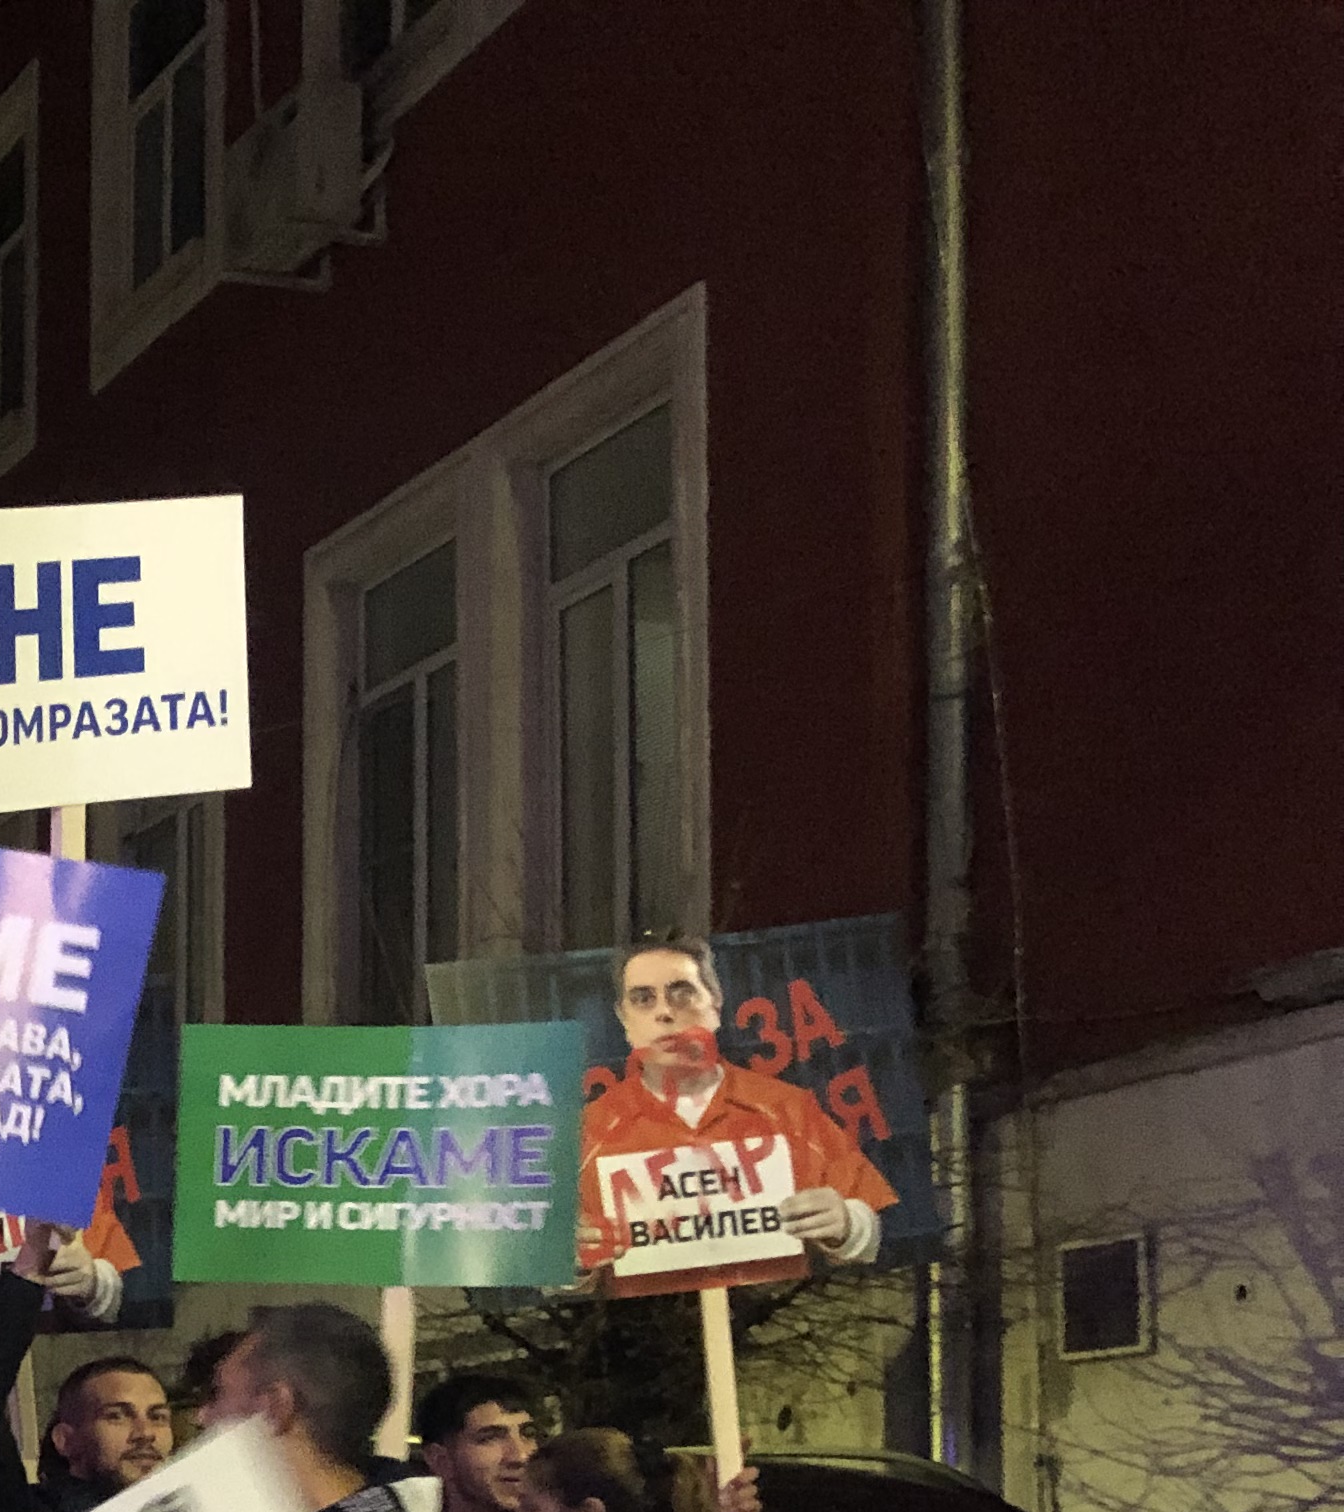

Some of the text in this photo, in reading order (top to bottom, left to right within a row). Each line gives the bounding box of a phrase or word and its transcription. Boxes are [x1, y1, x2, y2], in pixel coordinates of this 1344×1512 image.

[736, 978, 847, 1077] ЗА
[218, 1072, 554, 1115] МЛАДИТЕ ХОРА
[215, 1125, 556, 1189] ИСКАМЕ
[657, 1165, 741, 1201] АСЕН
[215, 1200, 553, 1231] МИР И СИГУРНОСТ
[629, 1204, 782, 1248] ВАСИЛЕВ
